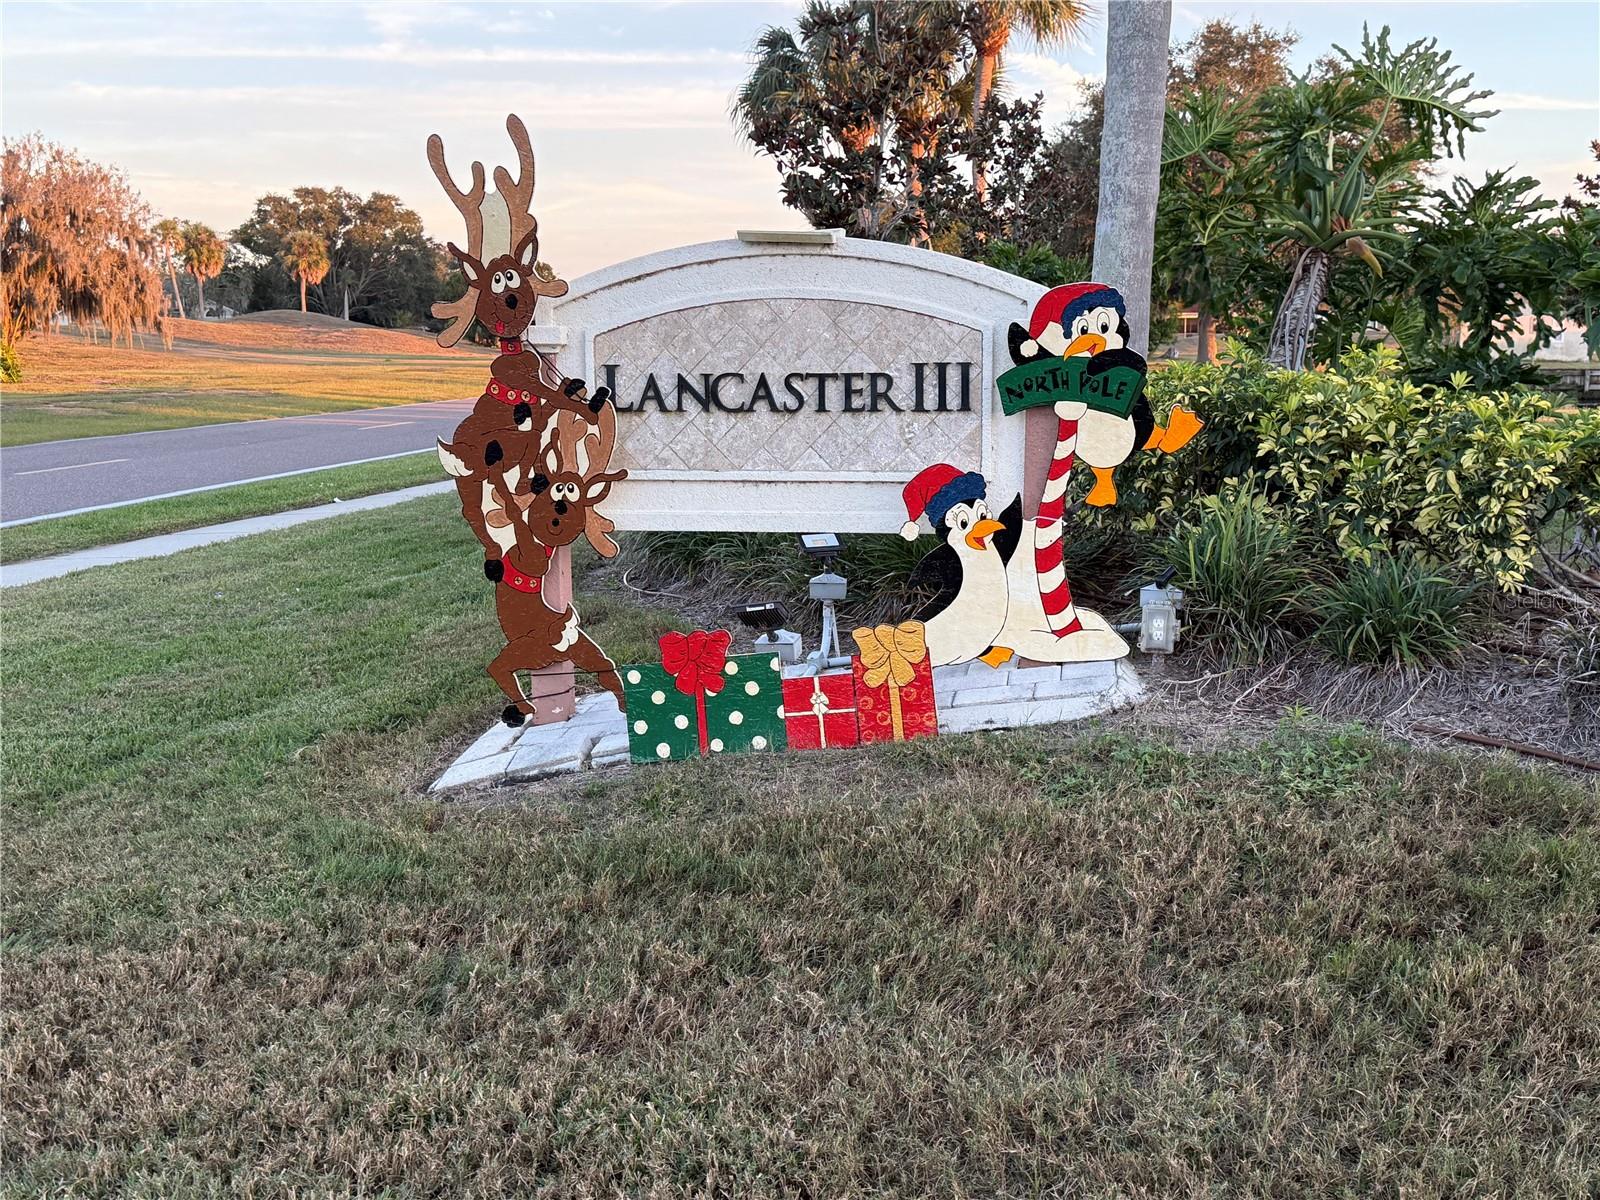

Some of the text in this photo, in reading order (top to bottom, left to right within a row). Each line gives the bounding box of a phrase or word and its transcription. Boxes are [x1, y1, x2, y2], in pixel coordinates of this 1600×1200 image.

[601, 361, 973, 413] LANCASTER III
[1005, 367, 1129, 404] NORTH POLE
